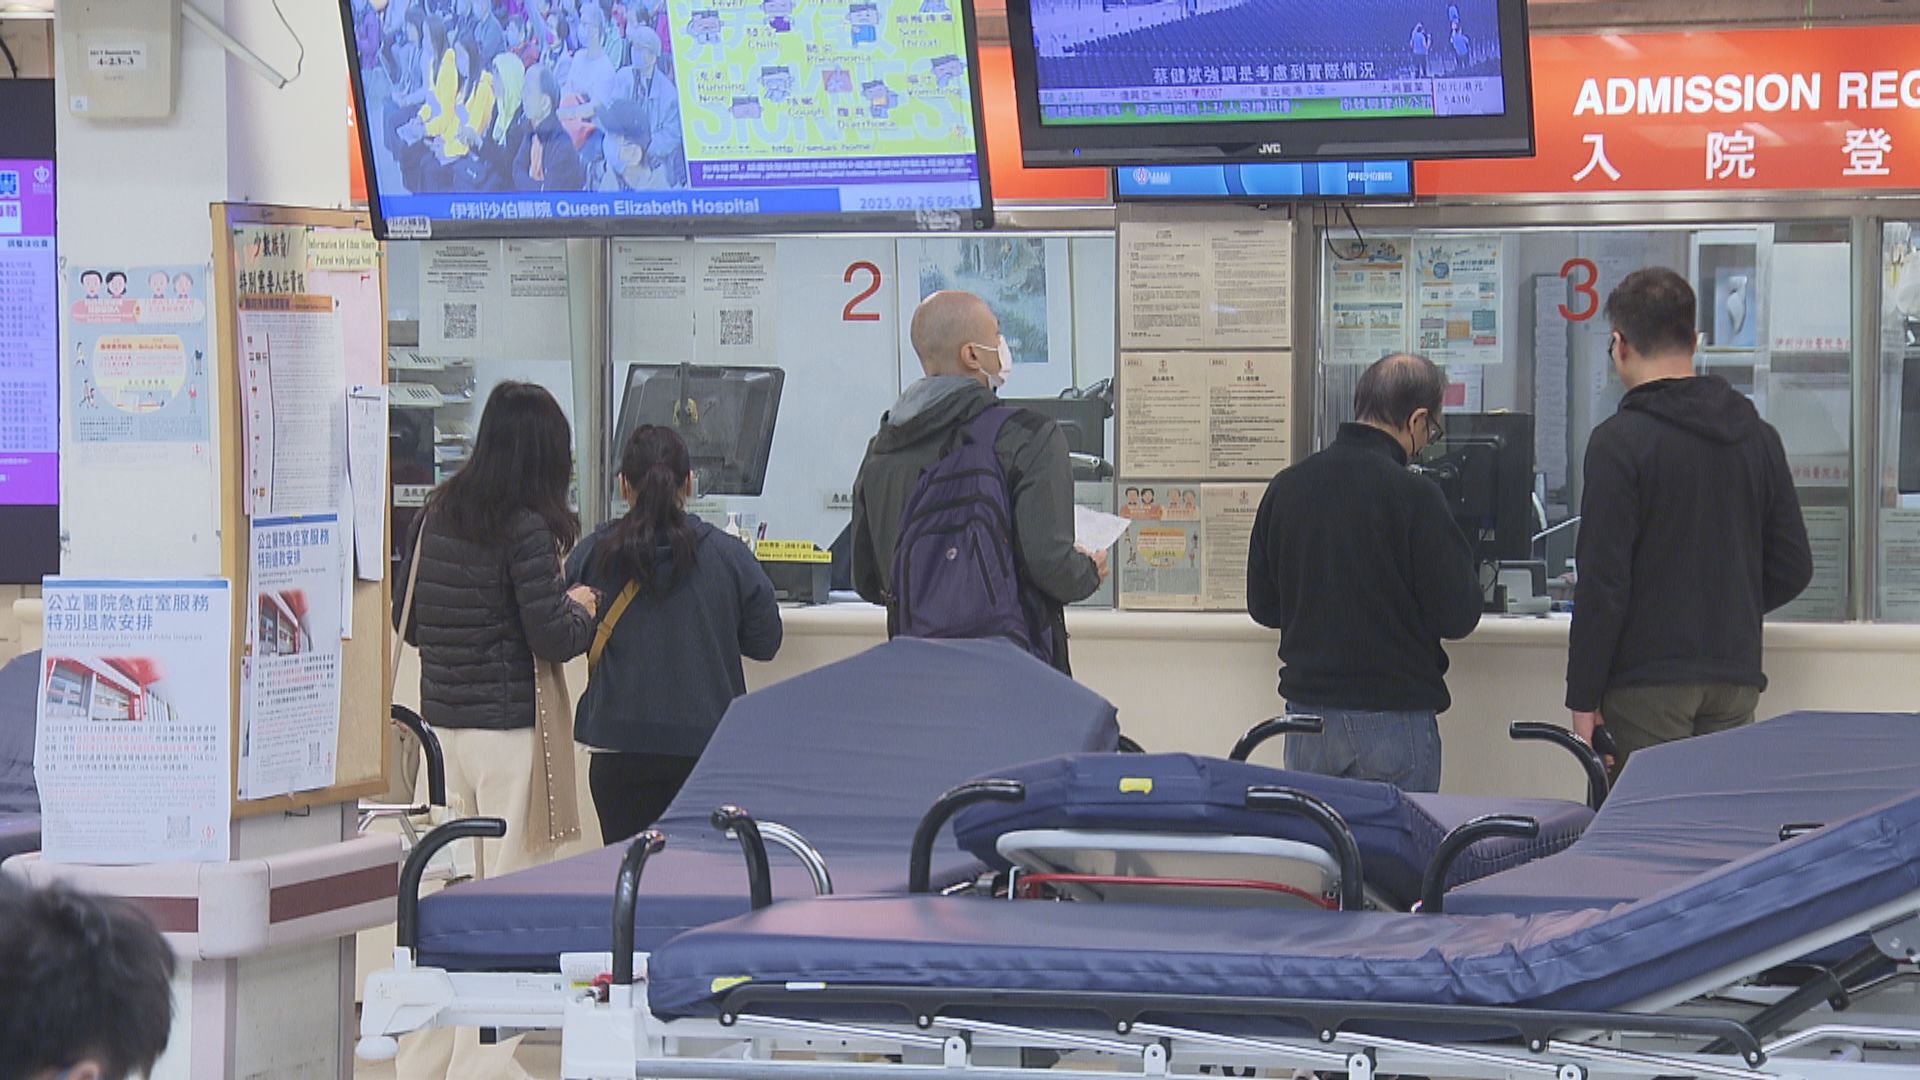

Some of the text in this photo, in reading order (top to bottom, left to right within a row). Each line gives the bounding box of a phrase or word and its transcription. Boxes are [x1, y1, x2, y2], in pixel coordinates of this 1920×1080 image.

[807, 55, 871, 63] Pneumonia
[1153, 61, 1375, 84] 蔡健斌強調是考慮到實際情況
[1573, 68, 1920, 116] ADMISSION REG
[1258, 143, 1281, 153] JVC
[450, 198, 760, 219] 伊利沙伯醫院 Queen Elizabeth Hospital
[860, 195, 974, 209] 2025.02.26 09:45
[842, 260, 881, 321] 2
[1558, 258, 1599, 322] 3
[257, 527, 330, 549] 公立醫院急症室服務
[257, 550, 301, 570] 特別退款安排
[47, 593, 209, 612] 公立醫院急症室服務
[47, 614, 153, 632] 特別退款安排
